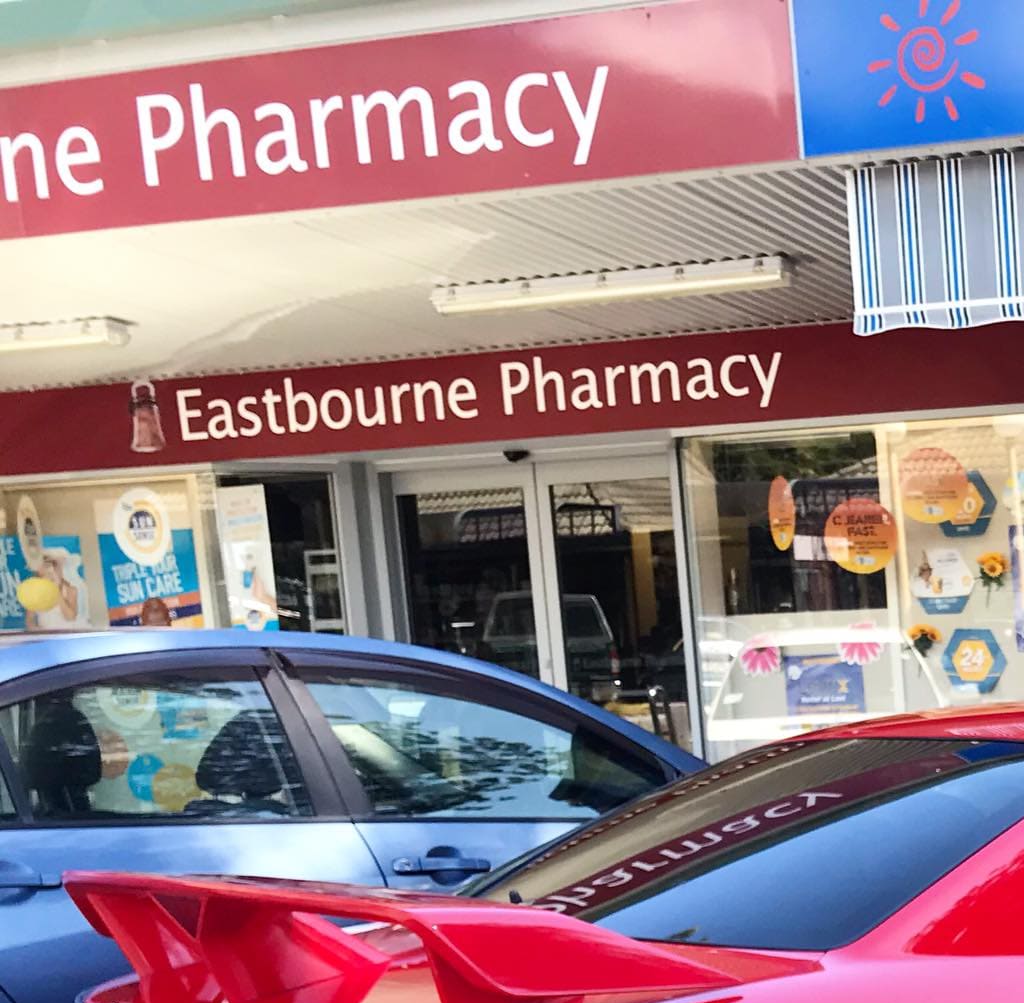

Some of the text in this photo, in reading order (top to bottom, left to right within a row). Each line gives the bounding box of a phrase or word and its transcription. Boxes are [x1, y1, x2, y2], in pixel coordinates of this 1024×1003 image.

[136, 66, 609, 187] Pharmacy
[176, 352, 782, 442] Eastbourne Pharmacy
